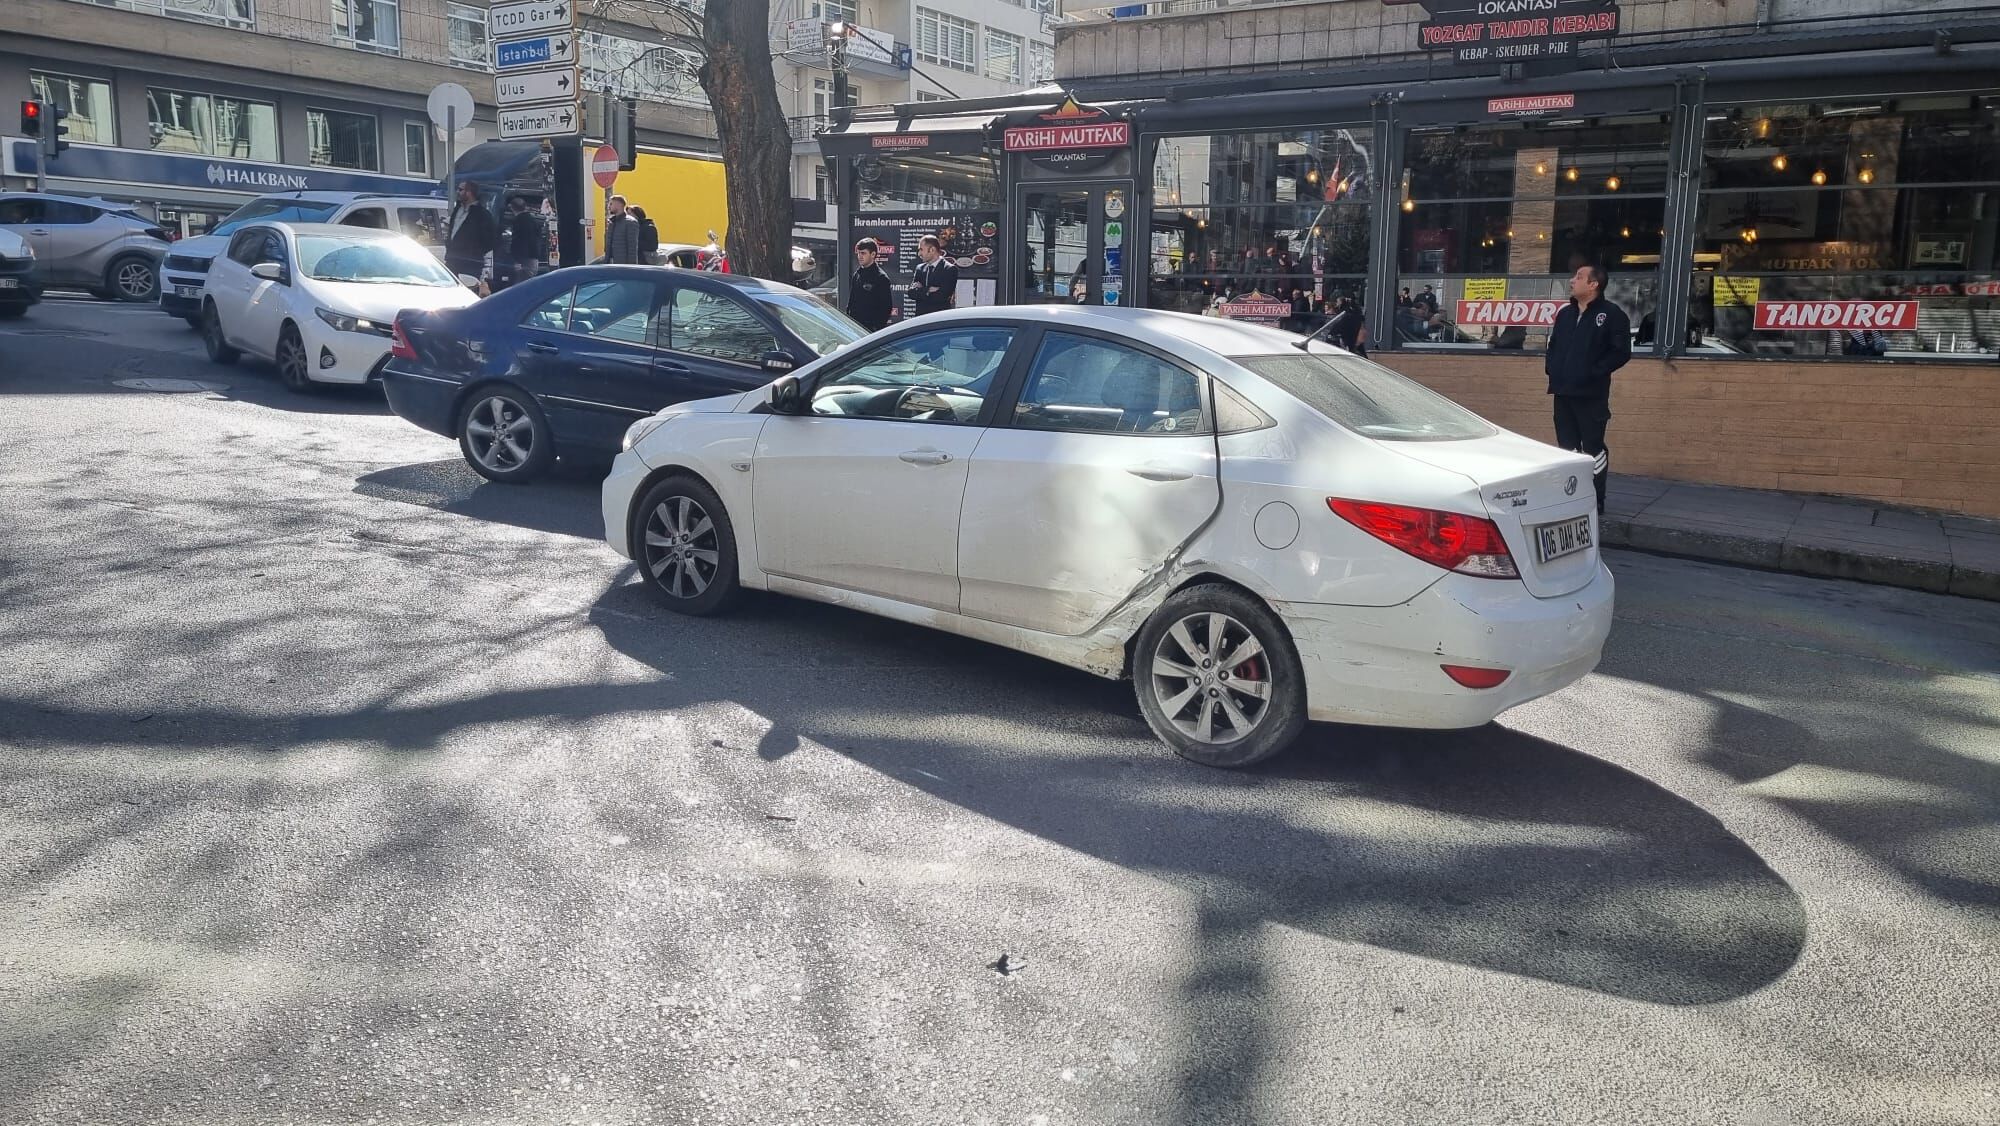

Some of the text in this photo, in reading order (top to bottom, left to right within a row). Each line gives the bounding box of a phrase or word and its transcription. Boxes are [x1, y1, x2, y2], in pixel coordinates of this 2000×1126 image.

[1477, 0, 1557, 15] LOKANTASI
[495, 9, 551, 27] TCDD Gar
[1422, 12, 1616, 45] YOZGAT TANDIR KEBABI
[1459, 47, 1488, 60] KEBAP
[500, 85, 525, 96] Ulus
[1527, 96, 1572, 108] MUTFAK
[1060, 126, 1123, 145] MUTFAK
[1050, 153, 1087, 162] LOKANTASI
[226, 168, 309, 190] HALKBANK
[1252, 305, 1288, 315] MUTFAK
[1765, 303, 1907, 328] TANDIRCI
[1545, 528, 1557, 556] 06
[1575, 519, 1589, 546] 465
